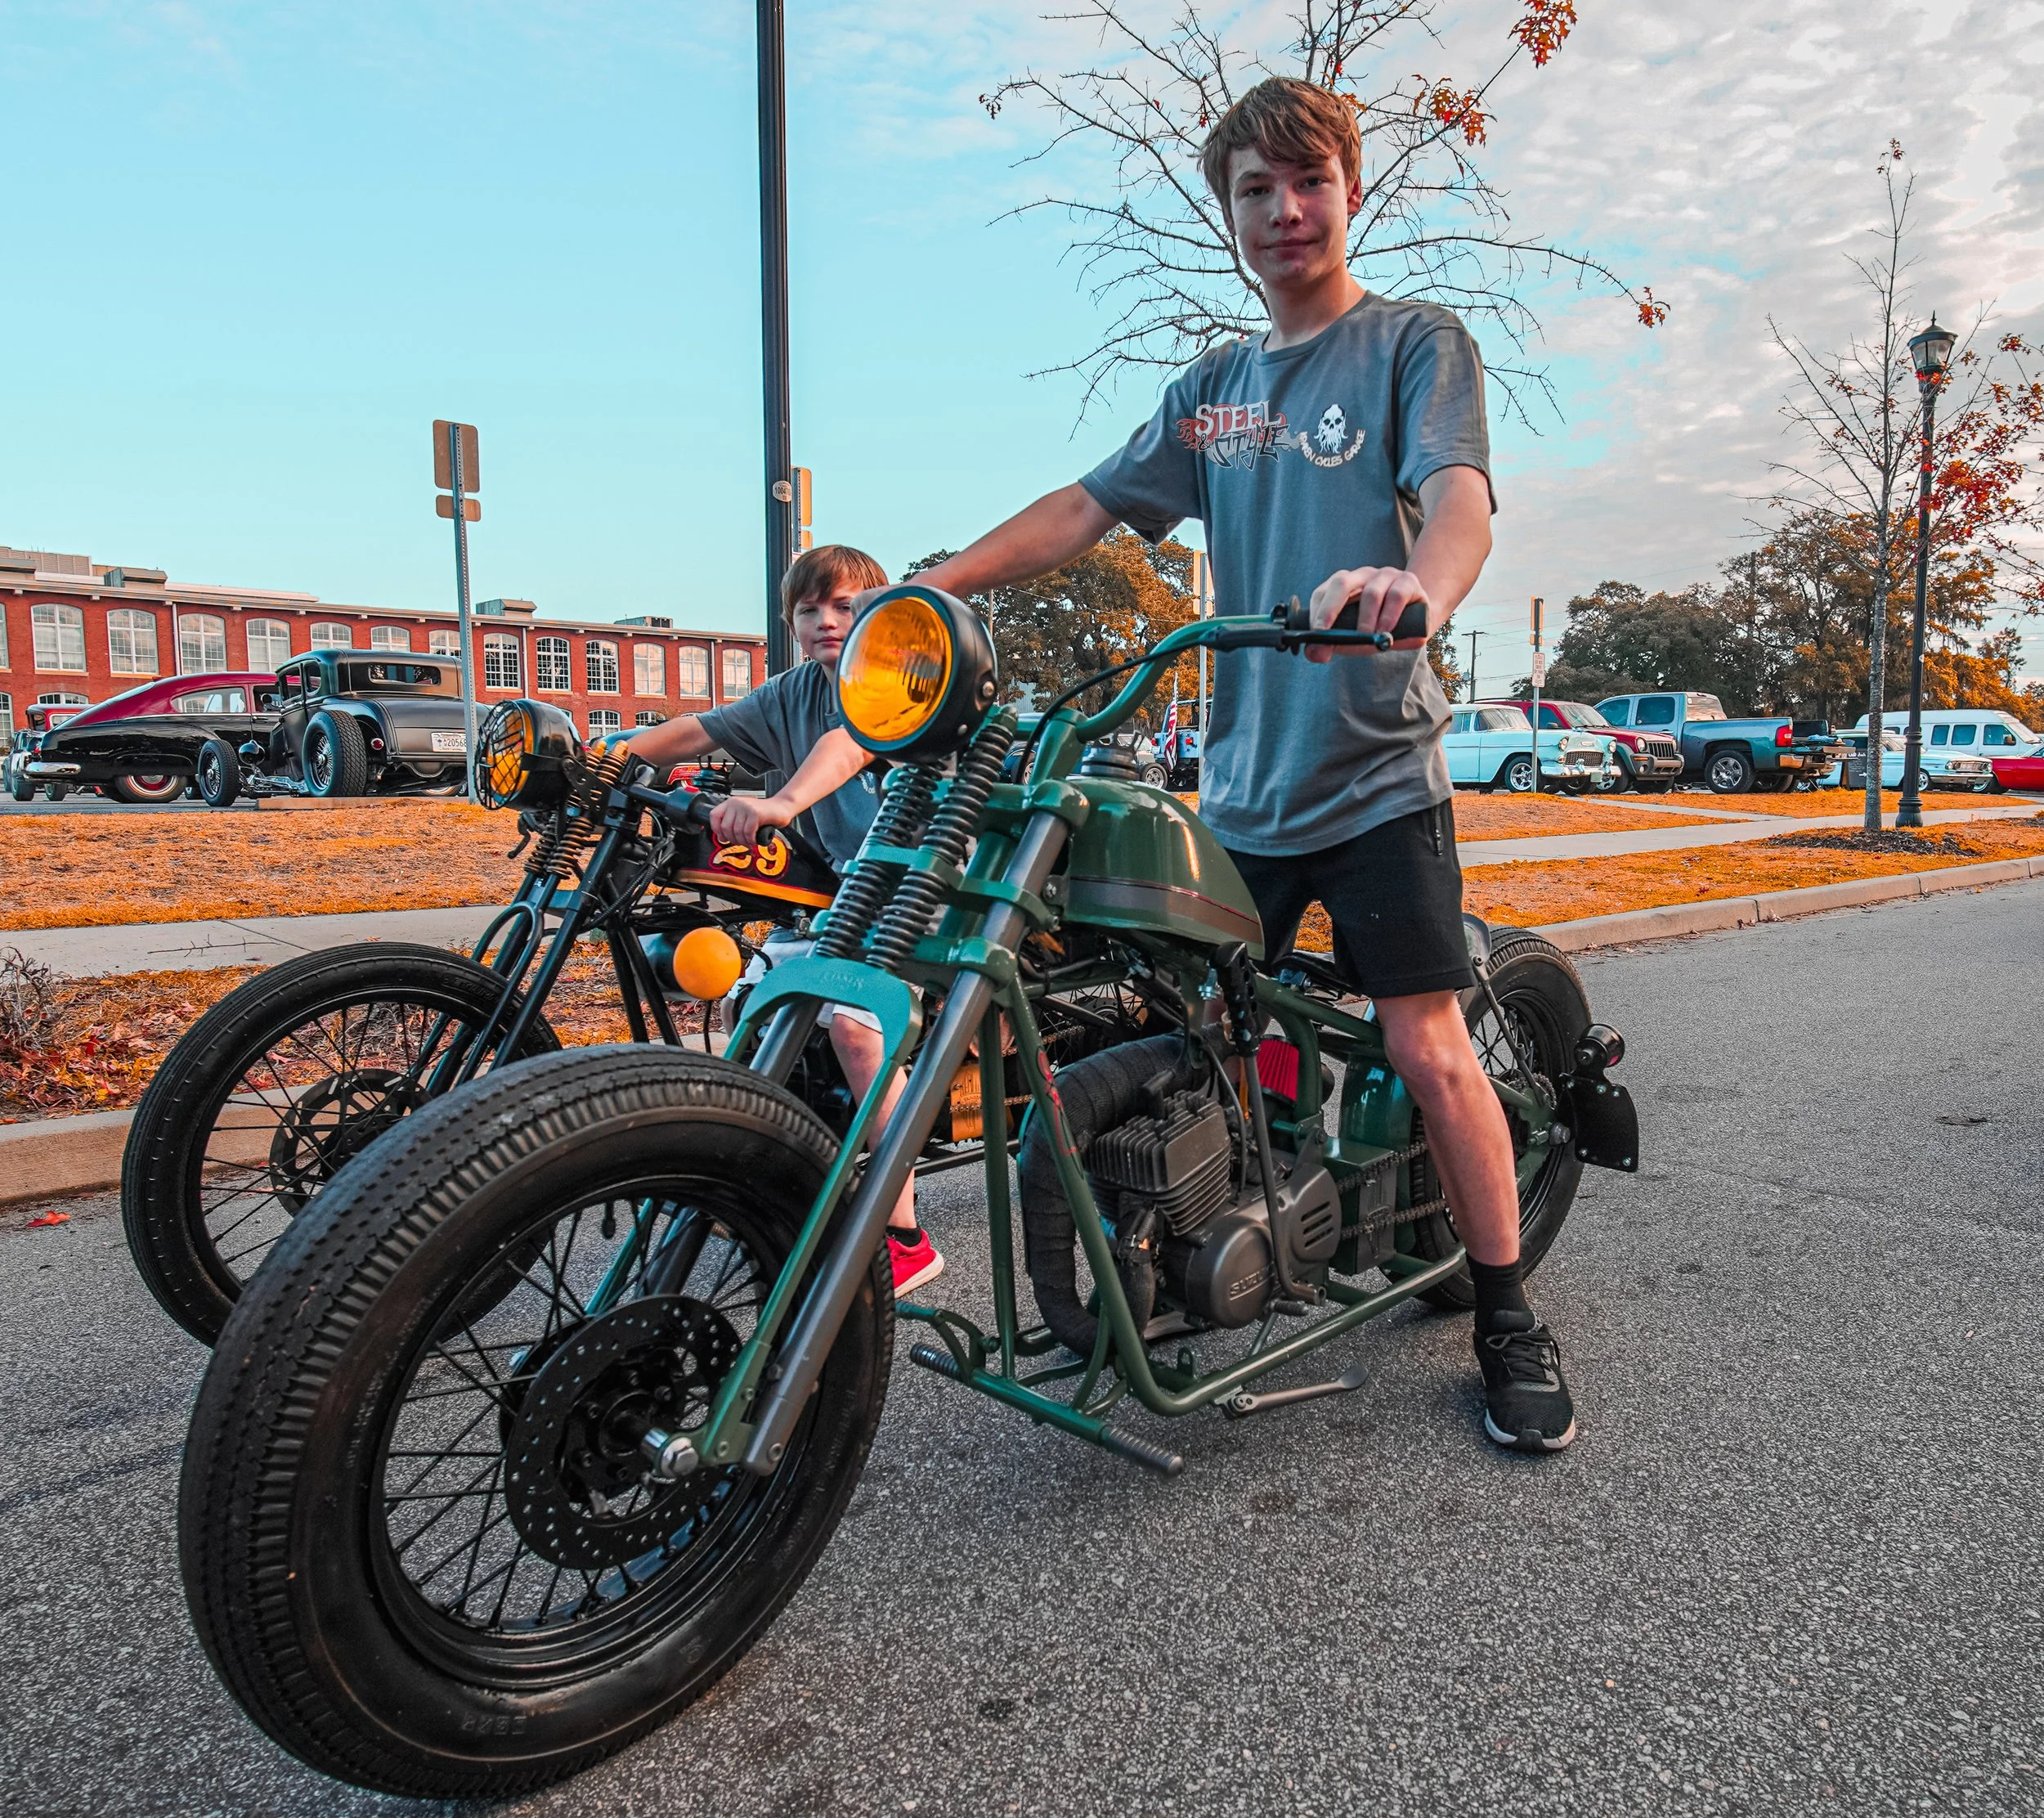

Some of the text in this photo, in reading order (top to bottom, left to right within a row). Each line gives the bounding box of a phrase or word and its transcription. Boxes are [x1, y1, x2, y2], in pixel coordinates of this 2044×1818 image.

[1195, 400, 1281, 437] STEEL
[1198, 423, 1290, 472] & STYLE
[1315, 455, 1343, 468] CYCLES
[1344, 429, 1366, 461] GARAGE
[712, 837, 787, 877] 29
